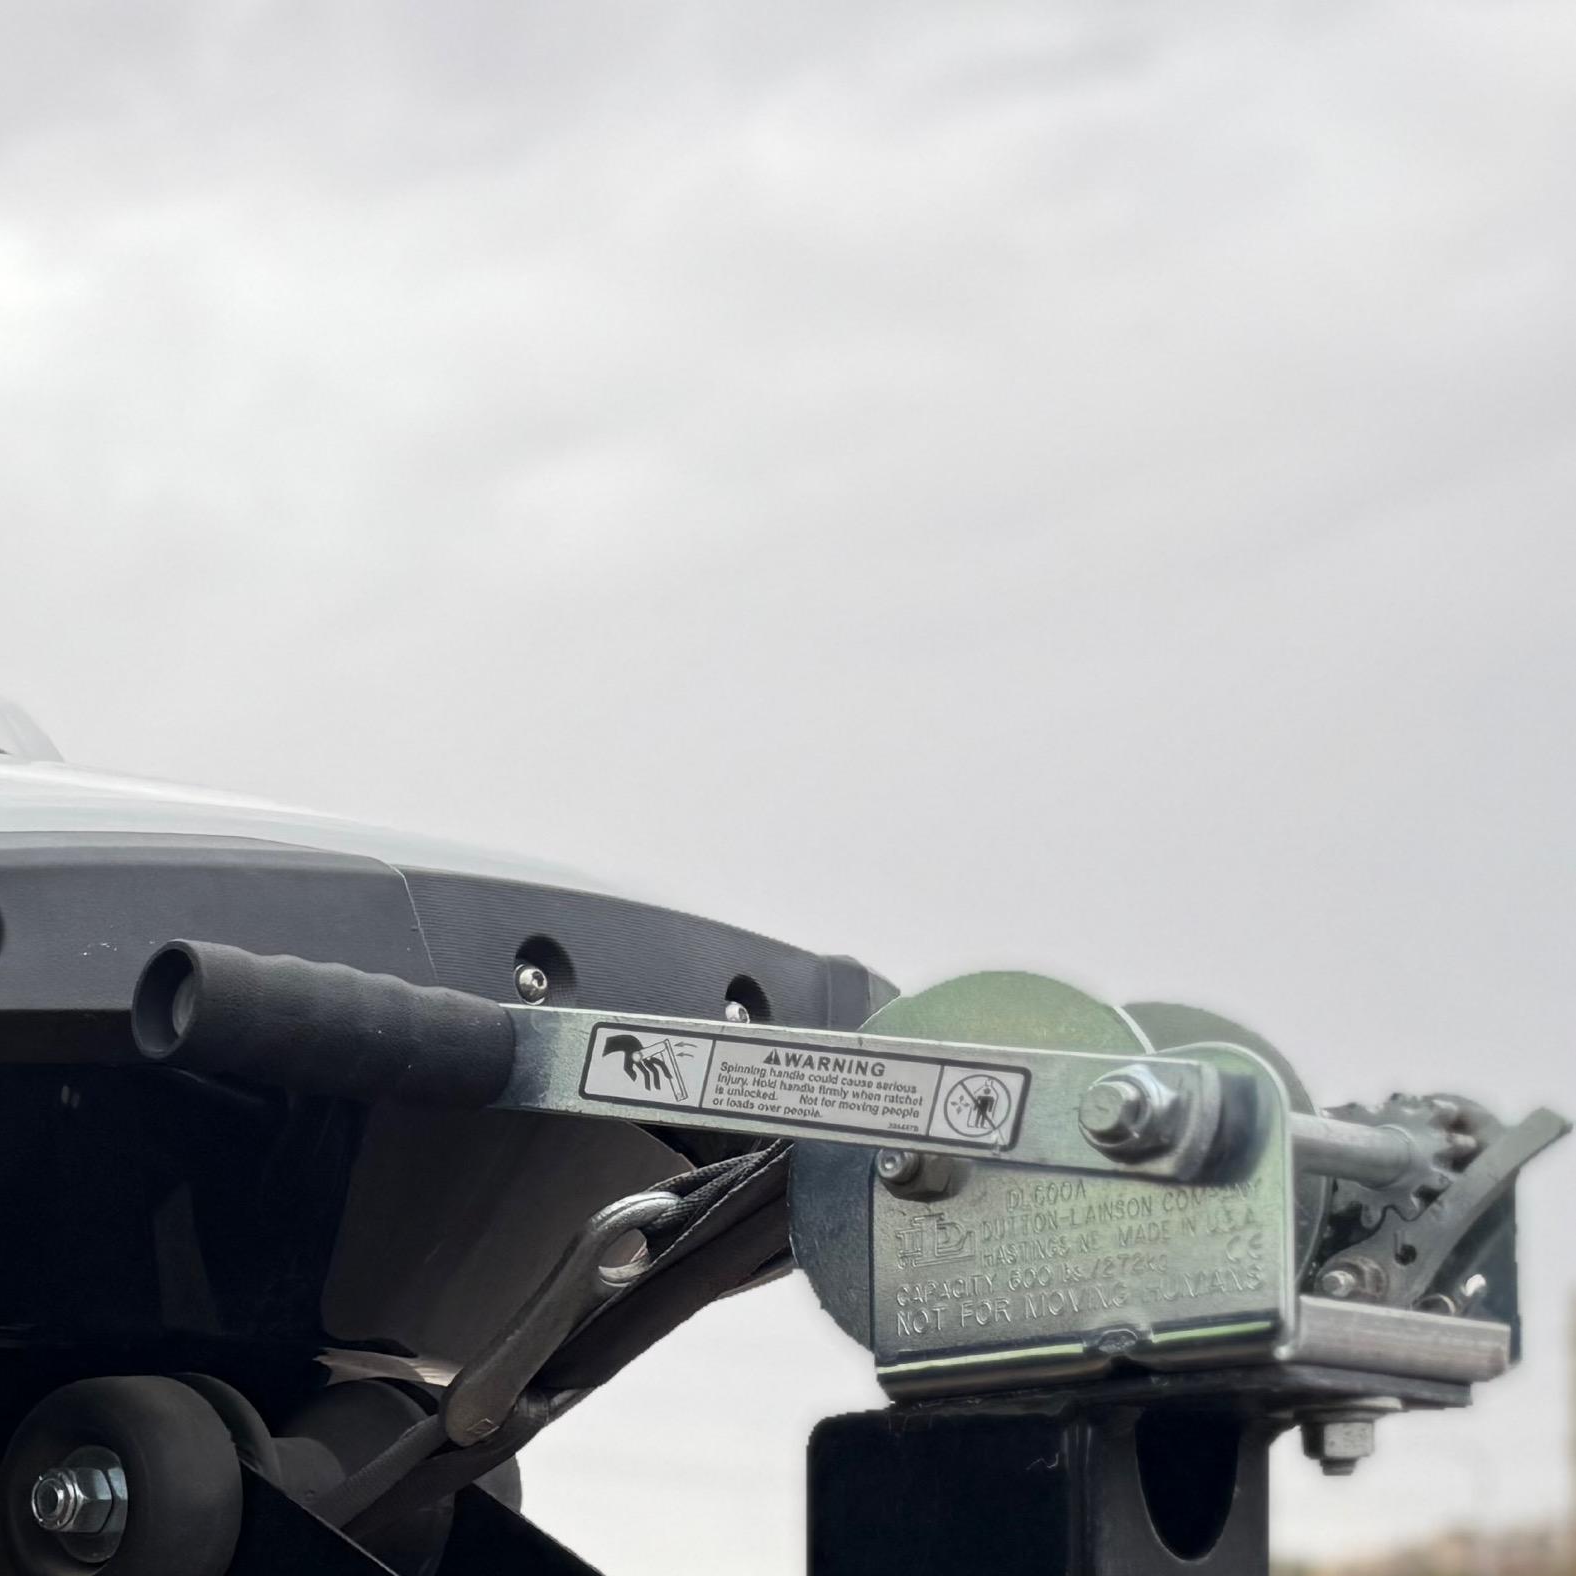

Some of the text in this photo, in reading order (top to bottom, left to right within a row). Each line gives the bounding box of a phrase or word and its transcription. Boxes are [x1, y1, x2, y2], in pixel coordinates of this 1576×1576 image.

[720, 1061, 917, 1094] Spinning handle could cause serious
[785, 1051, 886, 1077] WARNING
[712, 1097, 823, 1118] or loads over people.
[752, 1077, 777, 1089] Hold
[780, 1081, 815, 1093] handle
[819, 1085, 849, 1099] firmly
[852, 1090, 881, 1101] when
[884, 1094, 923, 1106] ratchet
[799, 1094, 818, 1106] Not
[821, 1097, 836, 1108] for
[838, 1100, 879, 1115] moving
[882, 1106, 920, 1119] people
[1007, 1178, 1087, 1213] DL600A
[981, 1194, 1153, 1241] DUTTON-LAINSON
[982, 1235, 1072, 1268] HASTINGS
[1117, 1219, 1172, 1247] MADE
[1182, 1216, 1197, 1238] IN
[896, 1264, 1264, 1337] NOT FOR MOVING HUMANS
[897, 1273, 997, 1307] CAPACITY
[1008, 1264, 1052, 1291] 600
